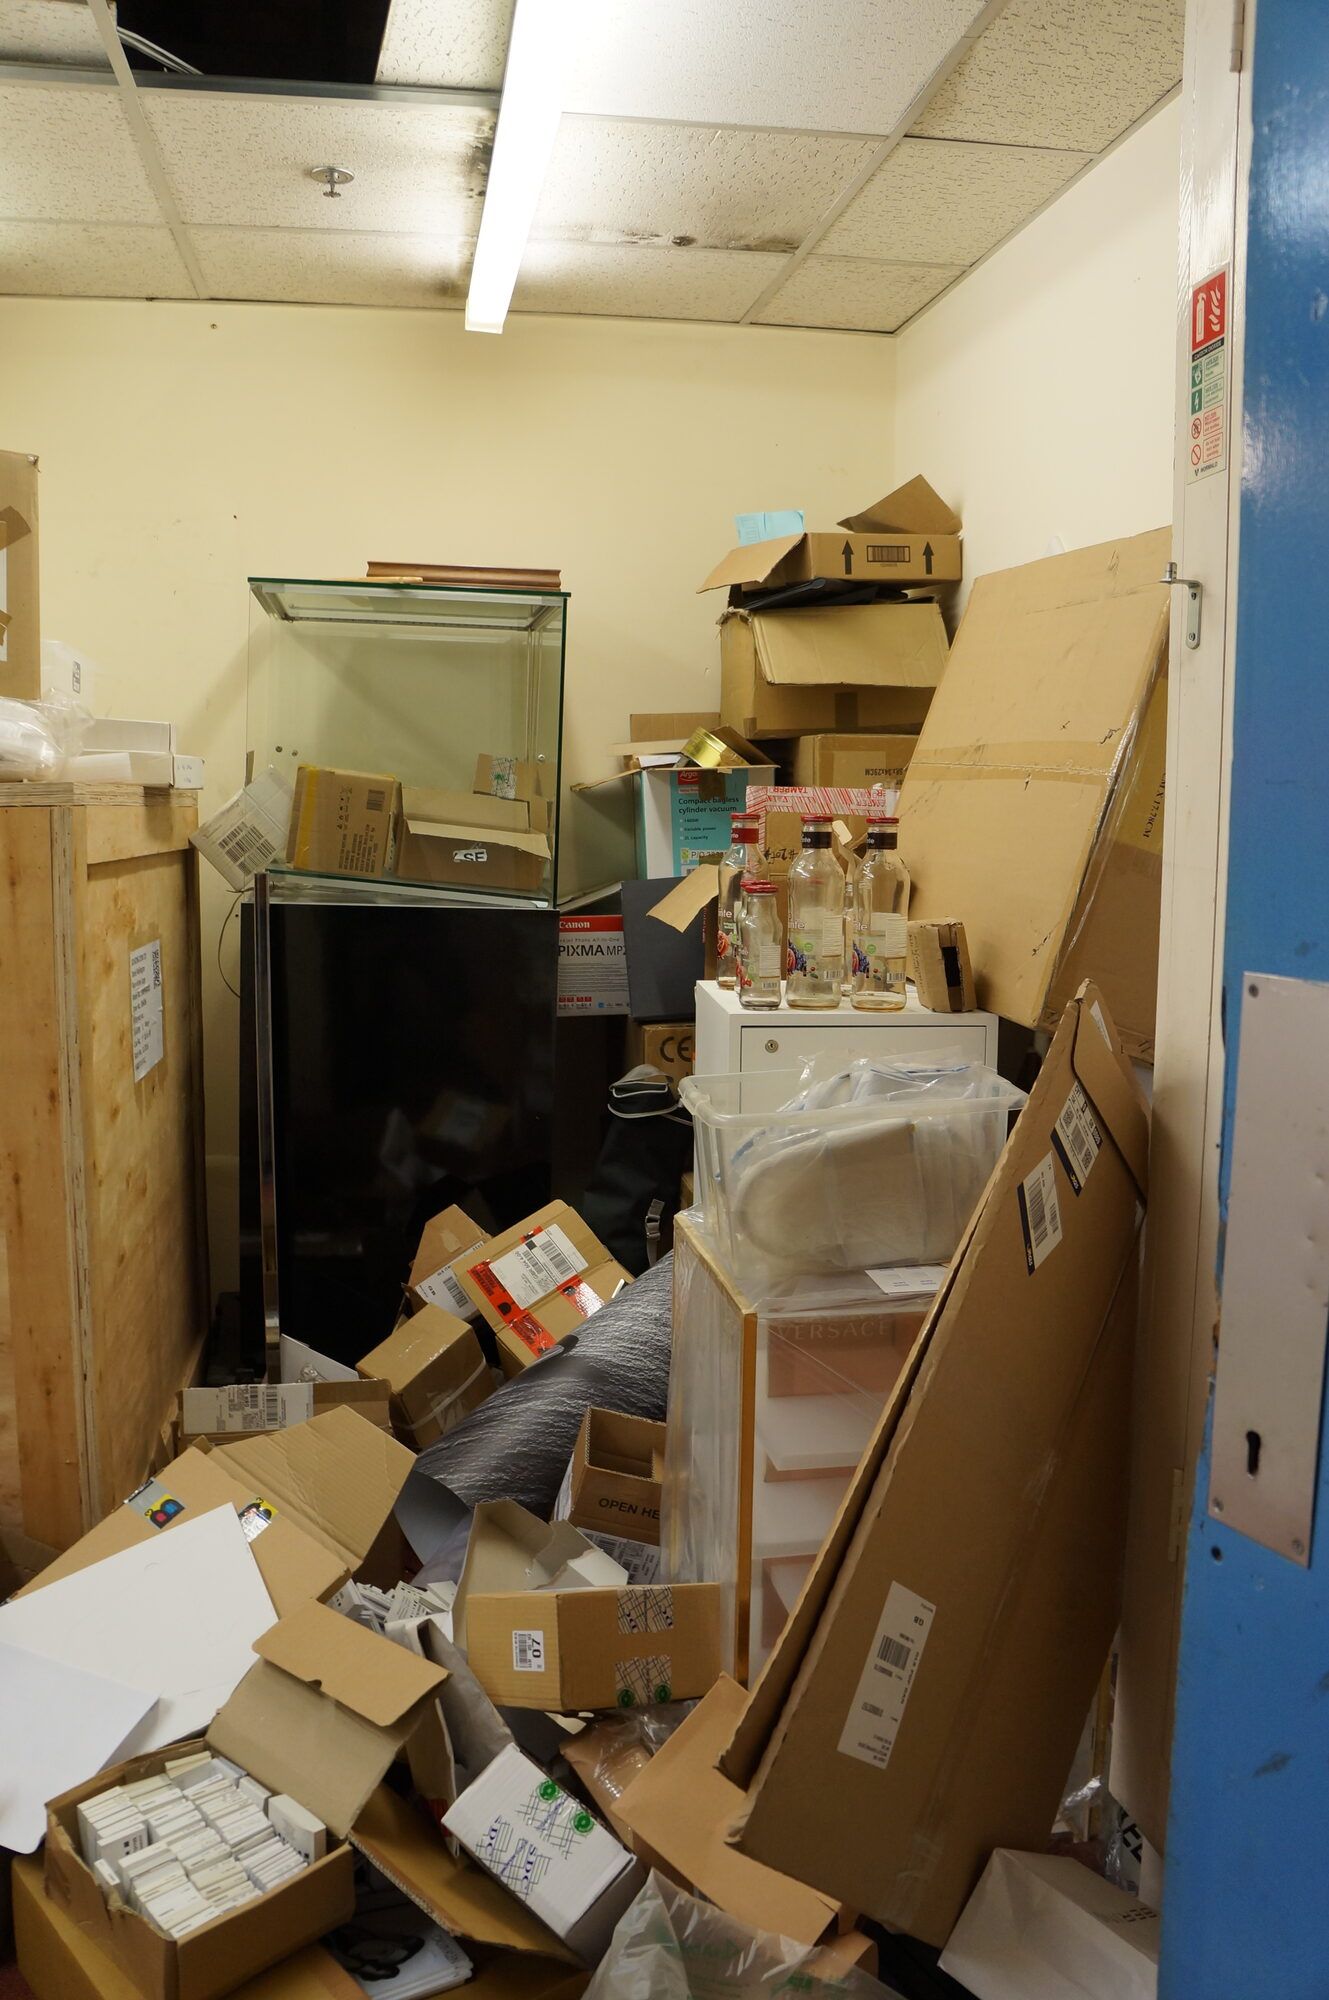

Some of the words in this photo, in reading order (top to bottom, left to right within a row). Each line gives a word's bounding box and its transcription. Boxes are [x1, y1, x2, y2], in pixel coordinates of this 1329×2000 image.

[678, 797, 711, 805] Compact
[678, 806, 707, 815] cylinder
[559, 920, 591, 929] Canon
[558, 944, 605, 957] PIXMA
[660, 1035, 694, 1064] CE
[776, 1319, 889, 1341] VERSACE
[598, 1497, 638, 1518] OPEN
[641, 1506, 660, 1520] HE
[530, 1637, 542, 1659] 07
